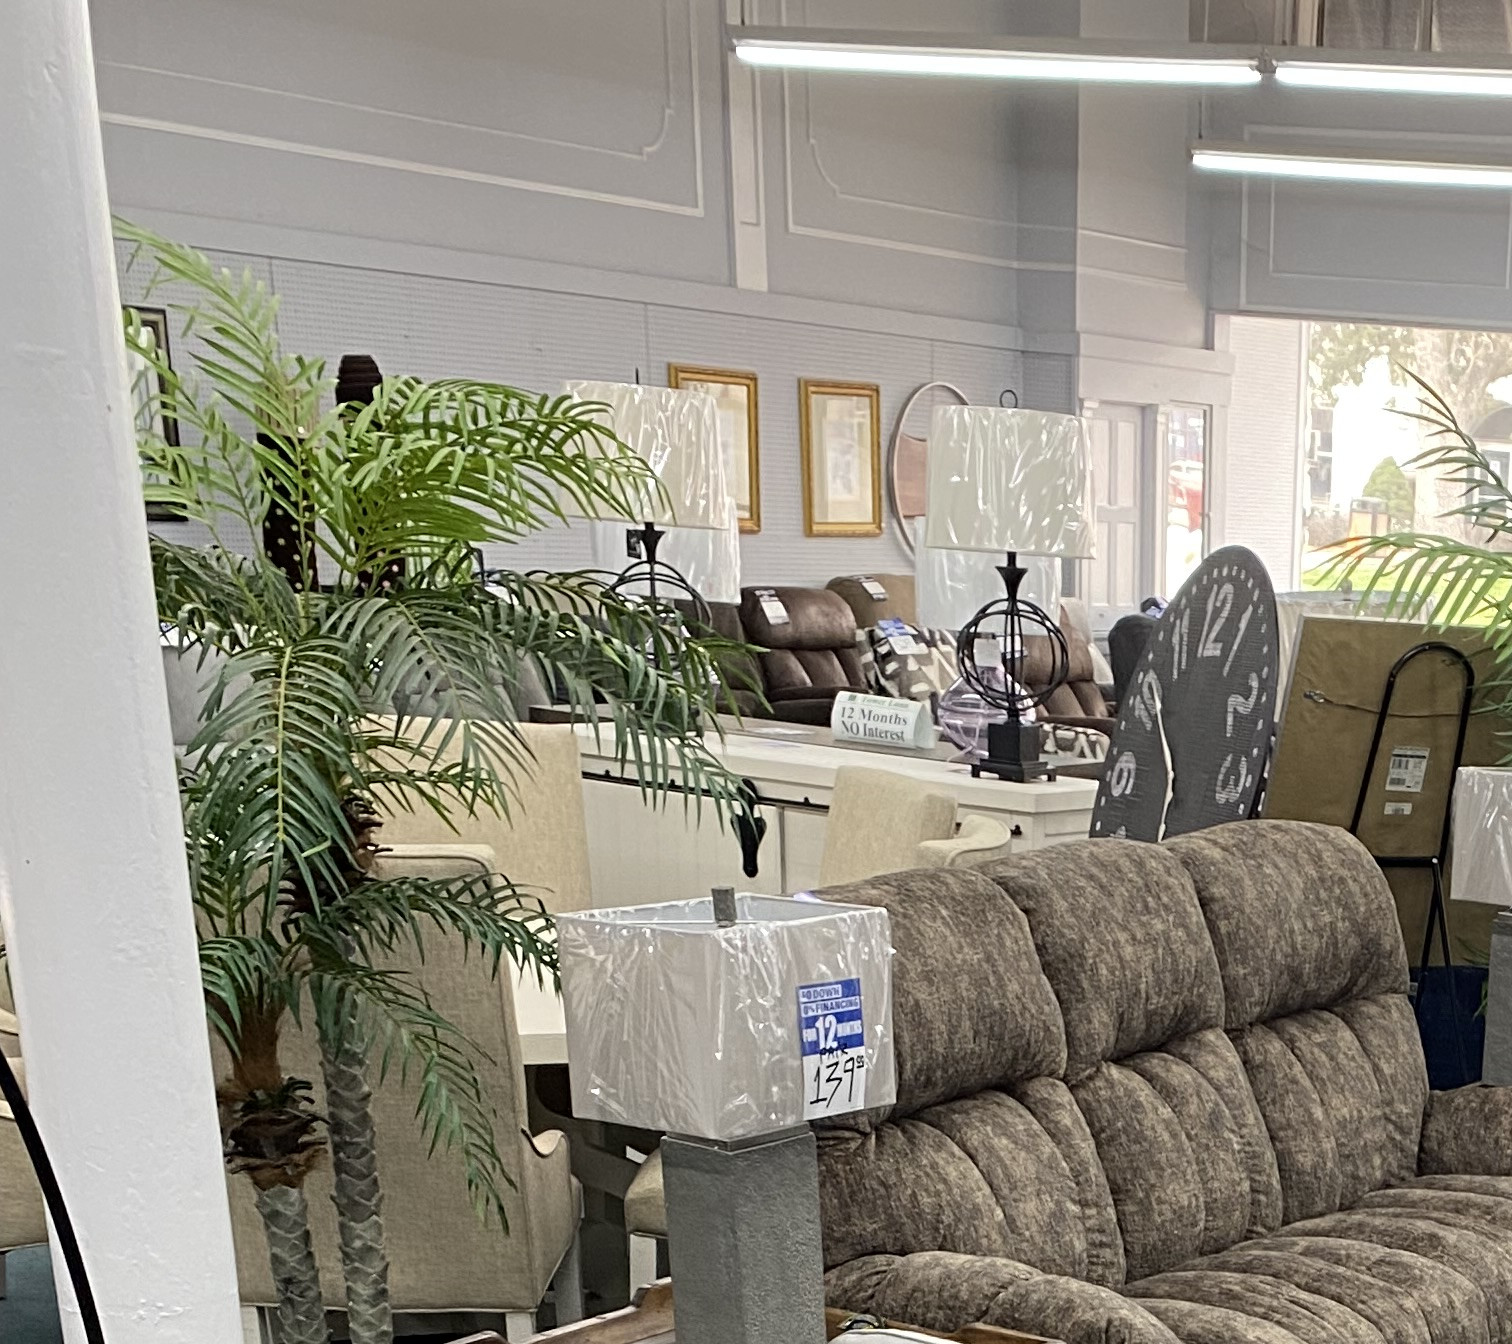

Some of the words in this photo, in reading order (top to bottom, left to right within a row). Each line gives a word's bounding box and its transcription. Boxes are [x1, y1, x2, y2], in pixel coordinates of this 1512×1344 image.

[1197, 582, 1235, 659] 12
[841, 706, 855, 719] 12
[858, 708, 908, 726] Months
[841, 719, 860, 736] NO
[863, 722, 905, 742] Interest
[814, 1014, 839, 1050] 12
[809, 1056, 855, 1109] 139
